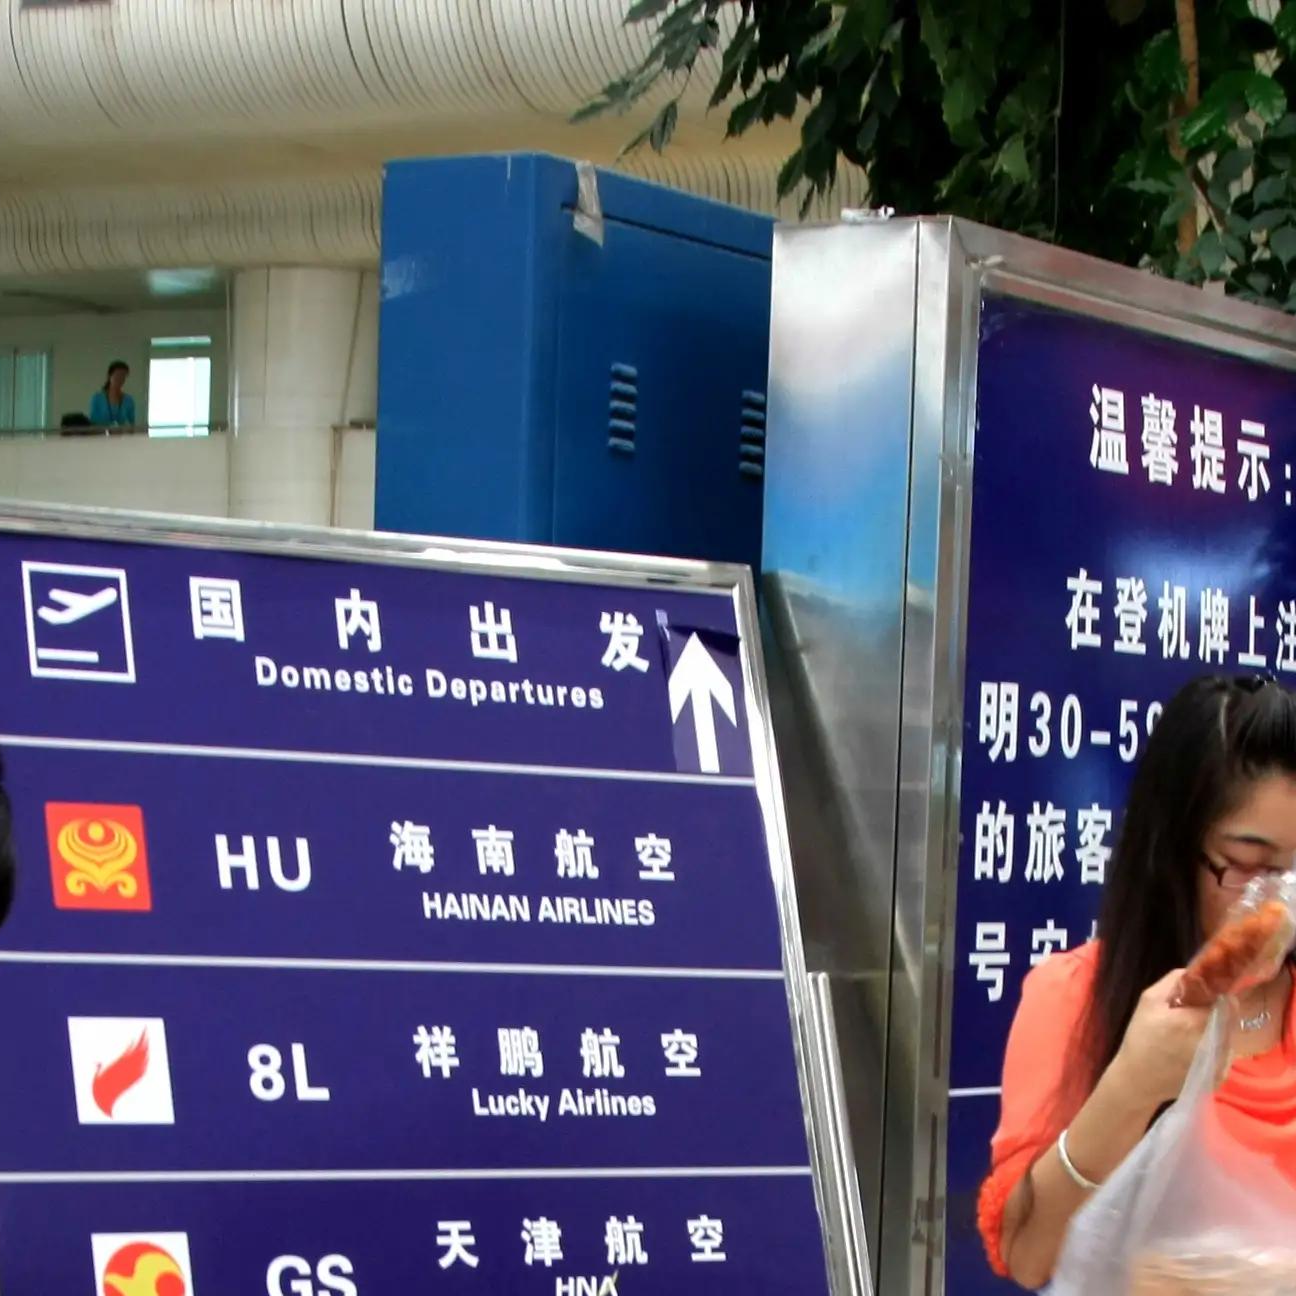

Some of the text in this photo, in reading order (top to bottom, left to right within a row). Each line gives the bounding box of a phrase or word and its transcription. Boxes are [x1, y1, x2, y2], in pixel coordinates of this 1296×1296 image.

[1089, 383, 1292, 505] 温馨提示:
[189, 576, 650, 673] 国内出发
[255, 655, 604, 710] Domestic Departures
[214, 833, 312, 892] HU
[389, 820, 676, 883] 海南航空
[974, 799, 1112, 885] 的旅客
[422, 891, 656, 927] HAINAN AIRLINES
[247, 1042, 331, 1102] 8L
[412, 1025, 702, 1079] 祥鹏航空
[471, 1087, 657, 1122] Lucky Airlines
[436, 1214, 727, 1269] 天津航空
